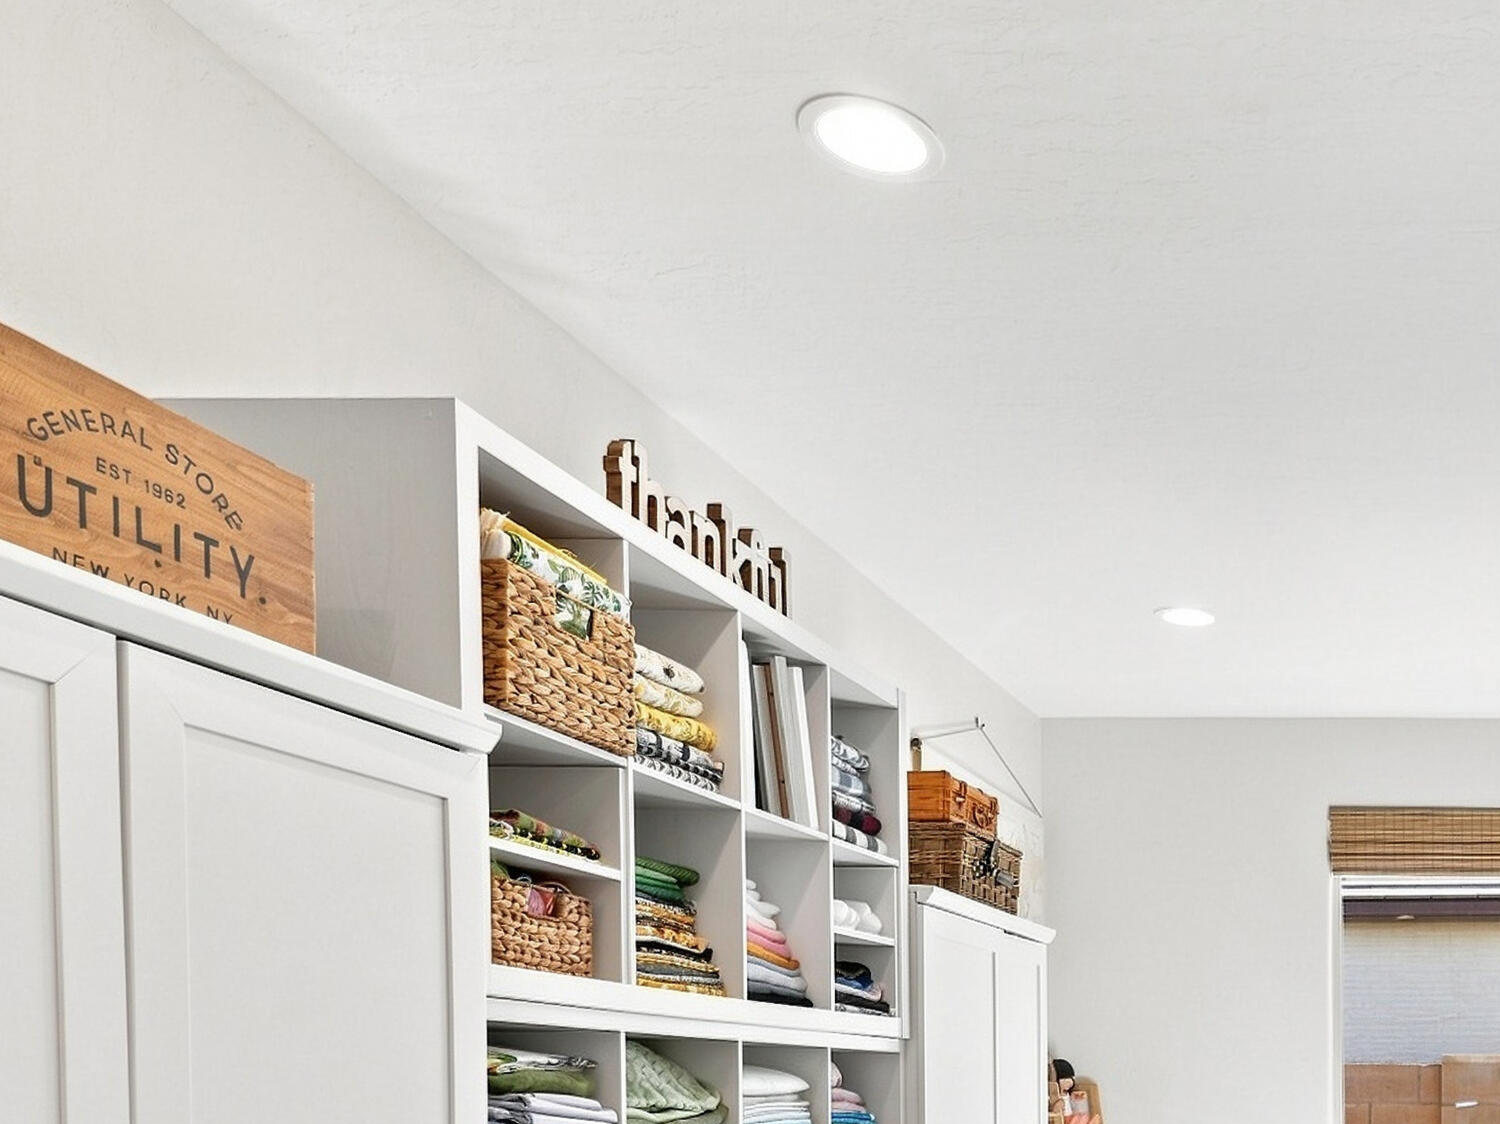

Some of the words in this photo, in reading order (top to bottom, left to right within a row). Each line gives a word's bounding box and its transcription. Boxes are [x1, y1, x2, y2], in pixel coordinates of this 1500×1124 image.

[26, 408, 152, 451] GENERAL
[164, 443, 243, 532] STORE
[96, 456, 131, 484] EST
[144, 479, 186, 509] 1962
[53, 547, 109, 579] NEW
[124, 573, 187, 608] YORK
